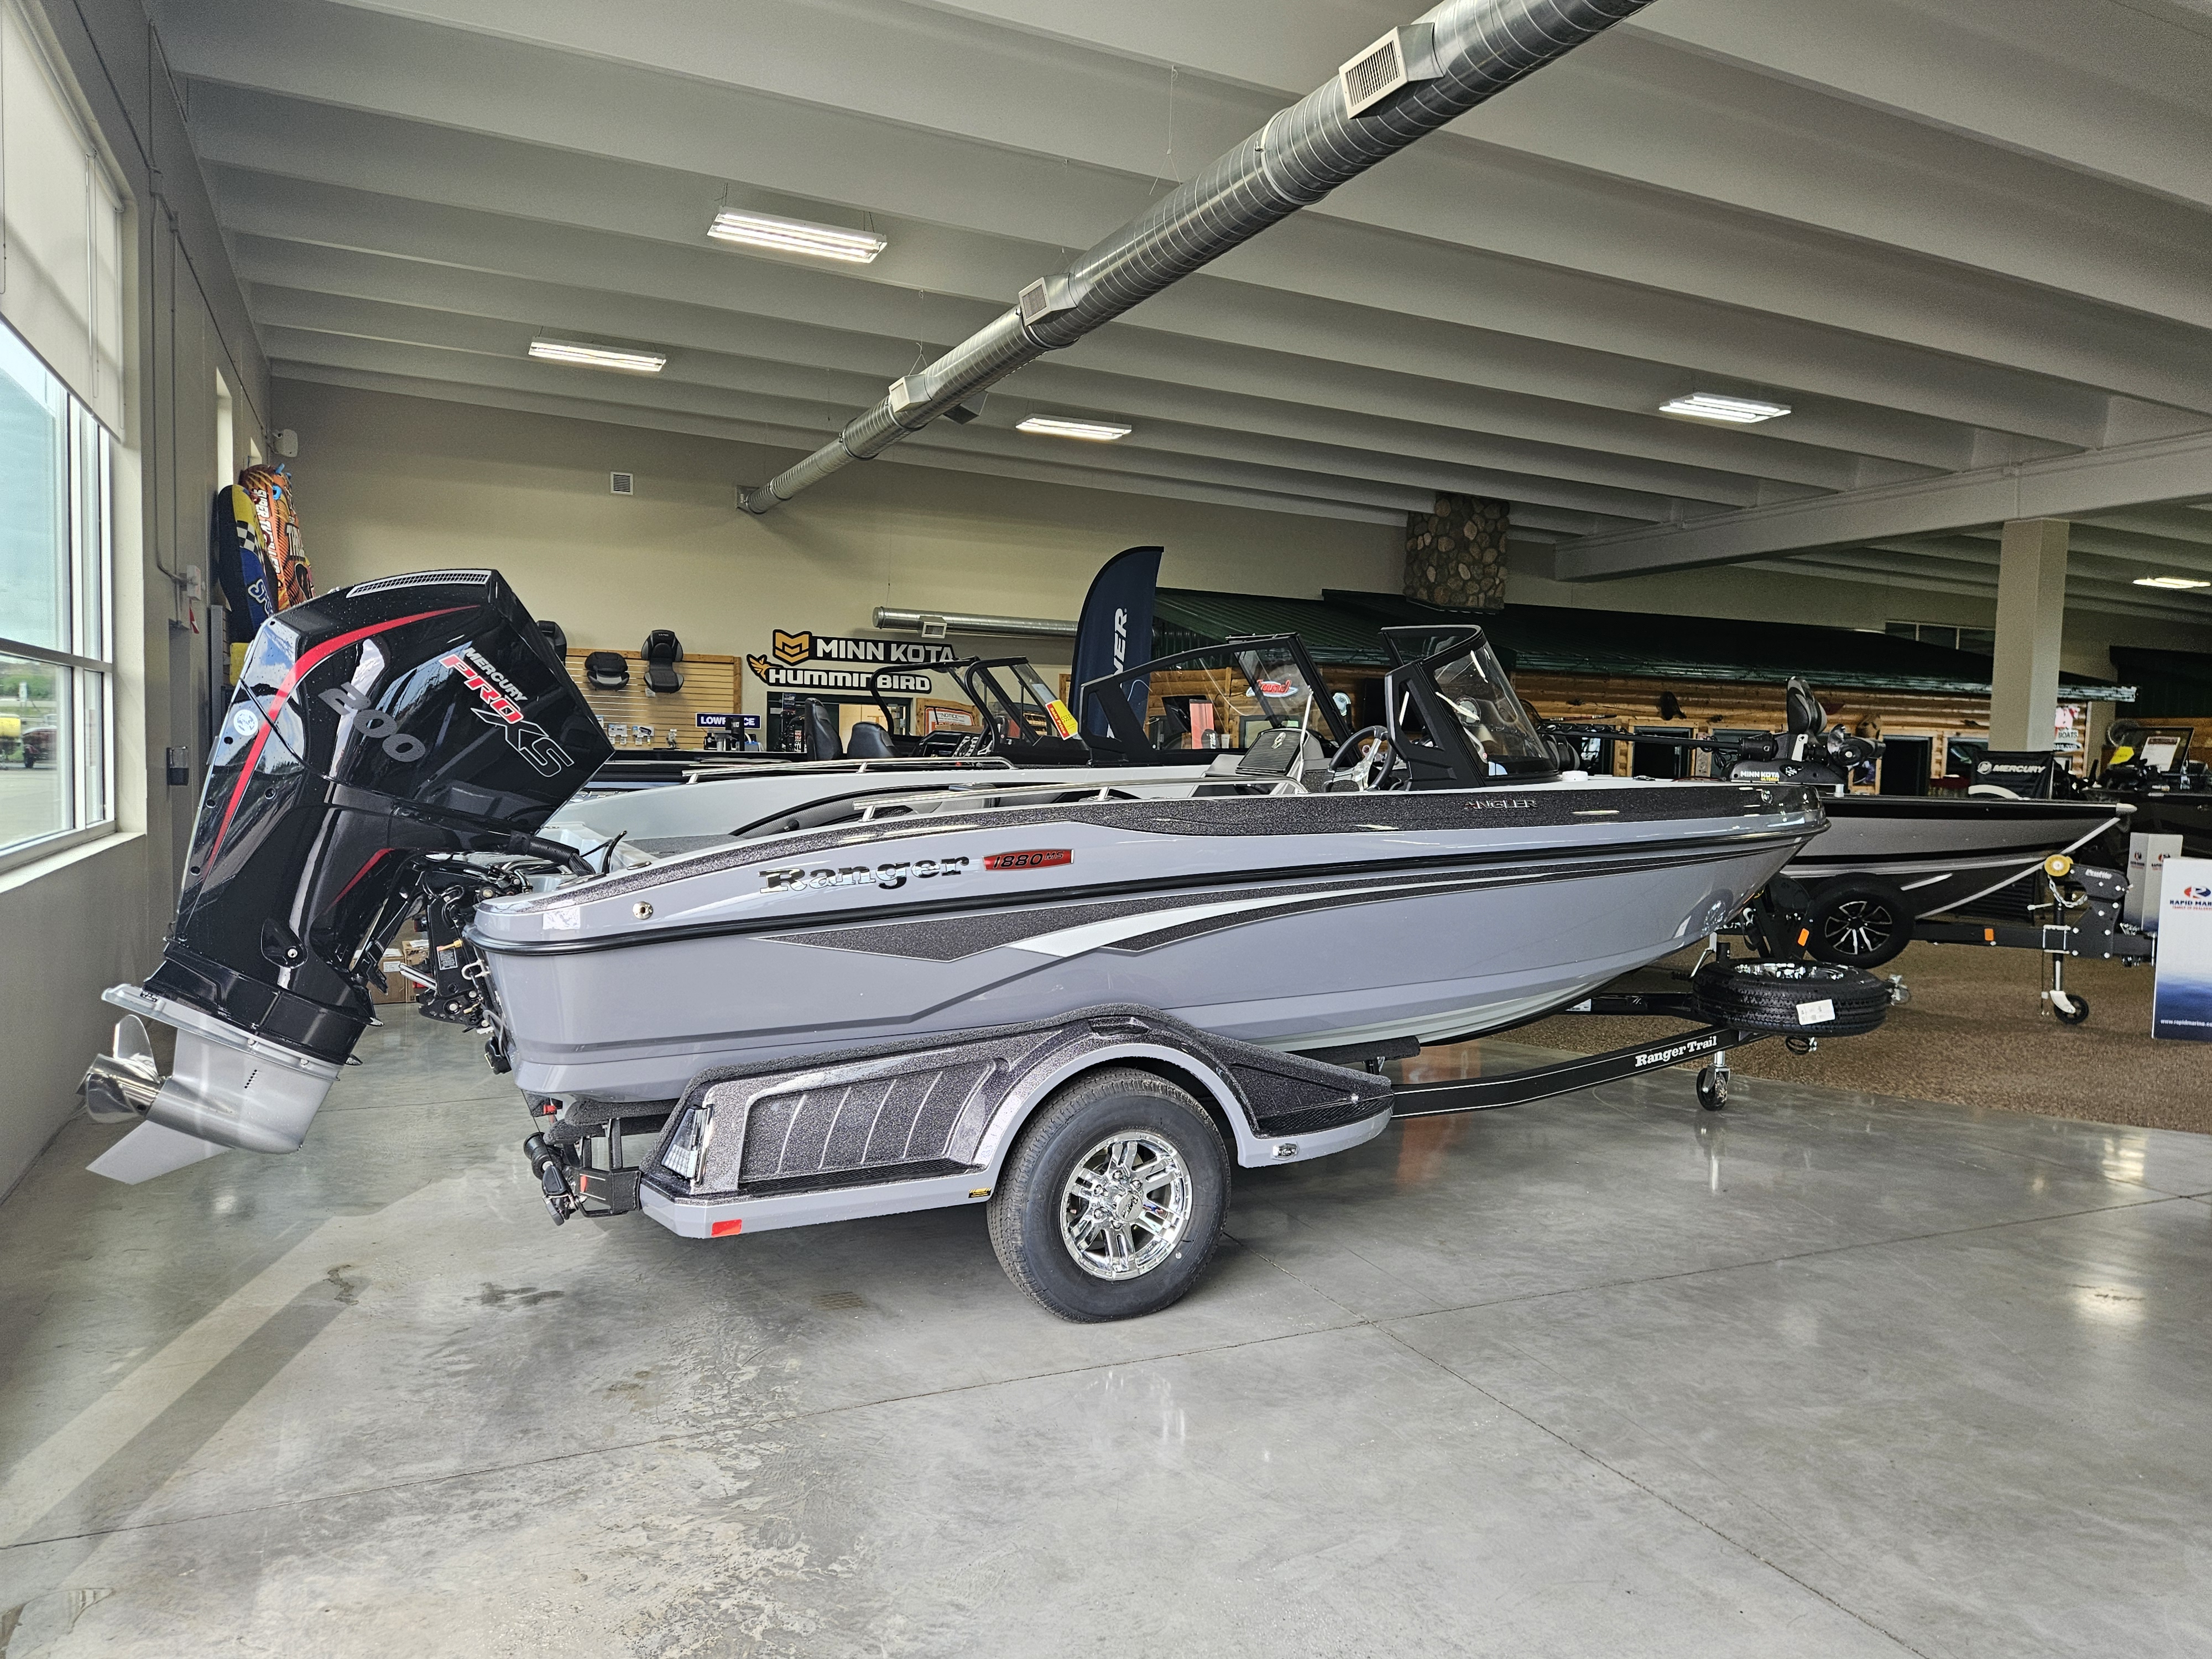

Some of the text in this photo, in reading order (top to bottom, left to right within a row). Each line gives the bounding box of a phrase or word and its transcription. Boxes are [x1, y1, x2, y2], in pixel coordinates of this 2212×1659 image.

[817, 638, 954, 662] MINN KOTA
[439, 653, 524, 724] PRO
[462, 647, 528, 702] MERCURY
[317, 681, 426, 763] 200
[471, 707, 575, 778] XS
[1992, 764, 2046, 774] MERCURY
[1464, 799, 1538, 810] ANGLER
[758, 855, 970, 894] Ranger
[1635, 1036, 1717, 1067] Ranger Trail
